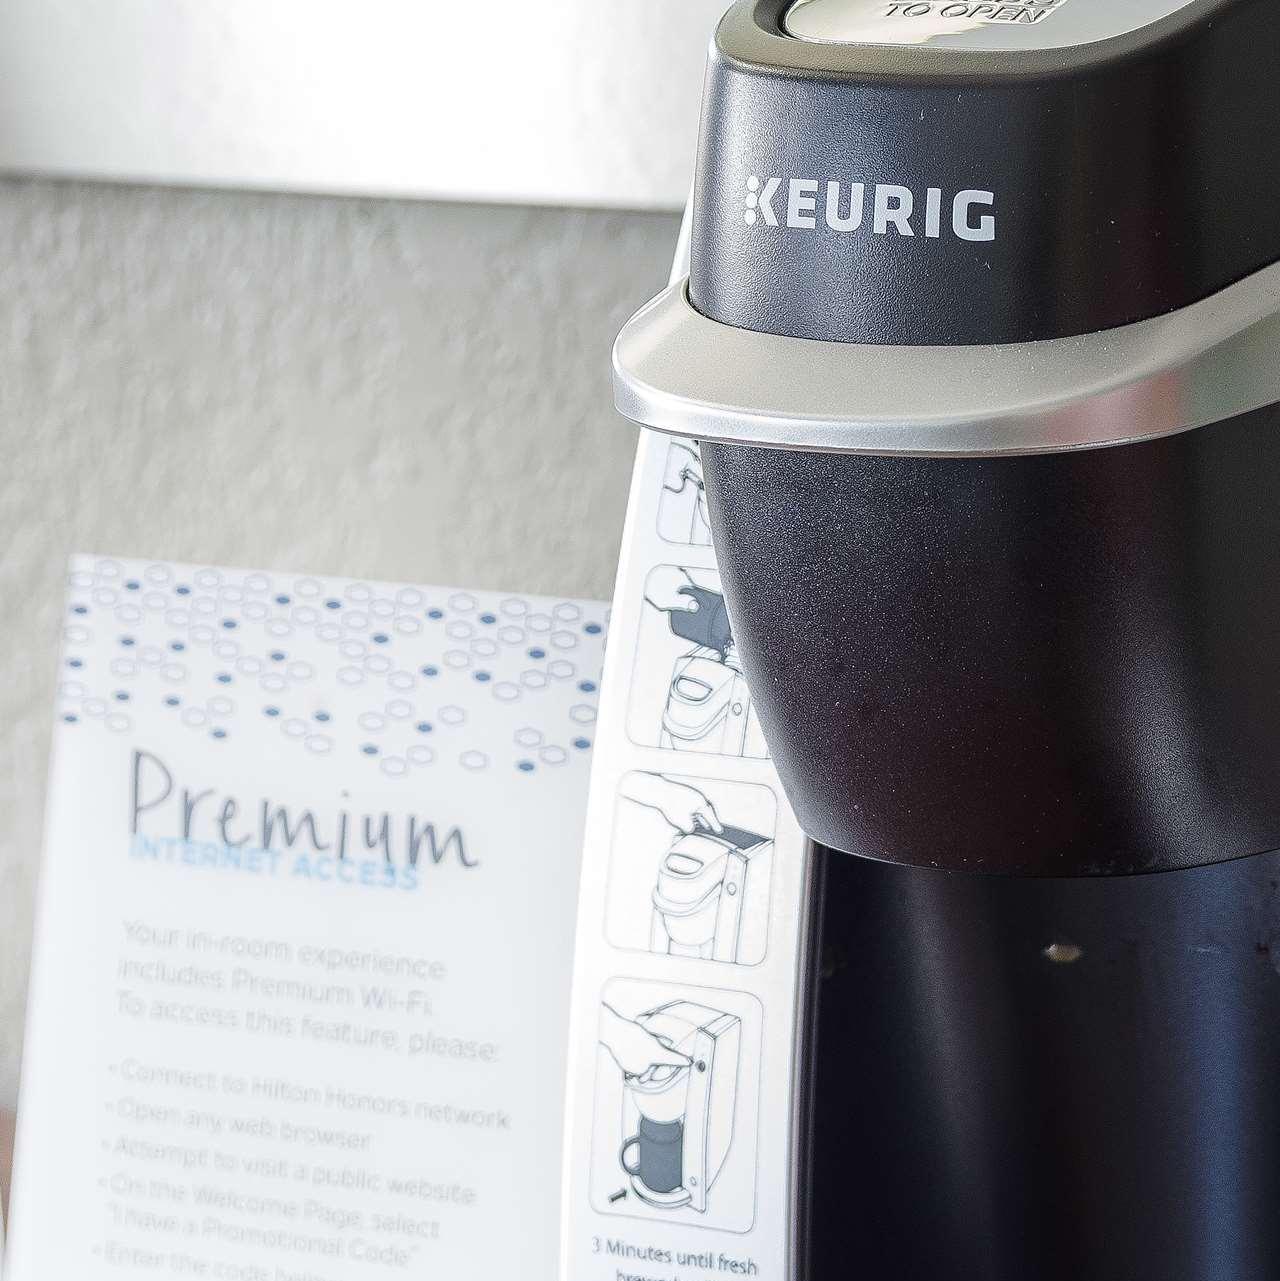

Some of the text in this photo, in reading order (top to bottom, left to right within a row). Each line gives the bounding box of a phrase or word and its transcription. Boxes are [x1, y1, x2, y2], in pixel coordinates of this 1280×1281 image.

[886, 2, 1046, 24] TO OPEN
[743, 174, 996, 243] KEURIG
[130, 747, 481, 869] Premium
[129, 833, 420, 891] INTERNET ACCESS
[297, 943, 448, 982] experience
[115, 988, 147, 1019] To
[413, 1100, 513, 1132] network
[279, 1121, 374, 1152] browser
[591, 1235, 759, 1276] 3 Minutes until fresh
